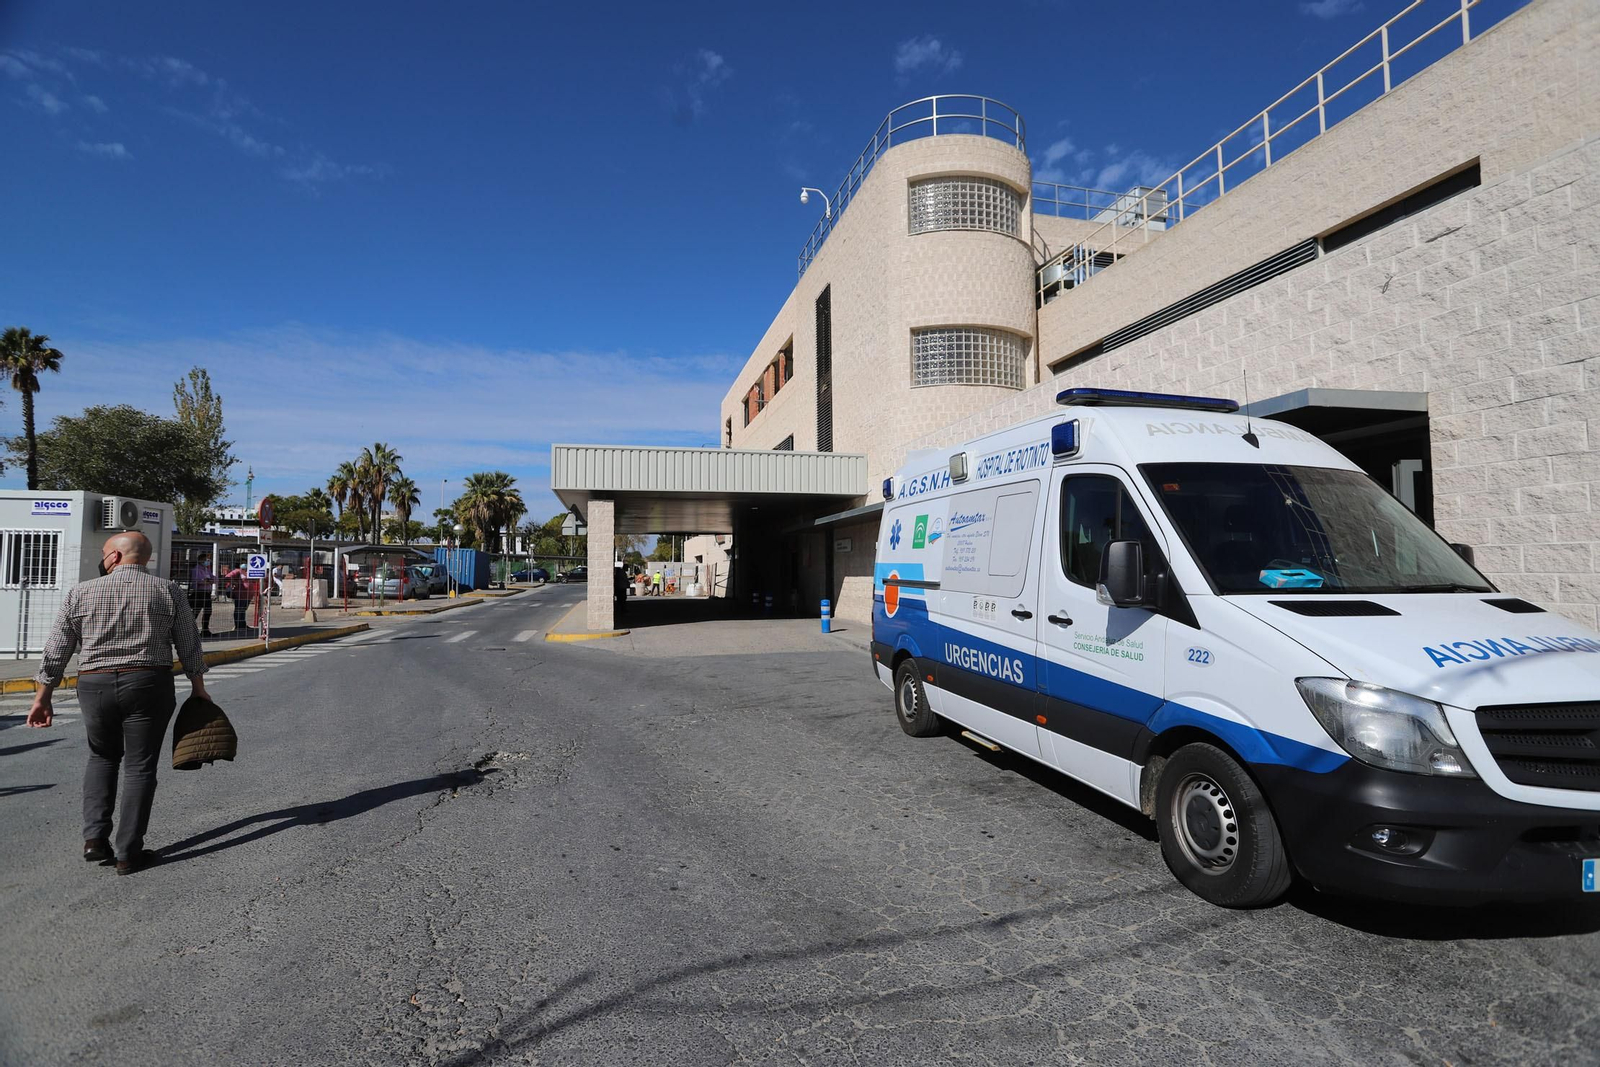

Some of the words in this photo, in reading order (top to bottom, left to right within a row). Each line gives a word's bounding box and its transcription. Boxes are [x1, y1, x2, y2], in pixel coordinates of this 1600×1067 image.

[977, 454, 1004, 480] HOSPITAL
[1004, 451, 1016, 474] DE
[1014, 442, 1049, 472] RIOTINTO
[34, 501, 68, 510] algeco
[1126, 638, 1144, 649] Salud
[1110, 648, 1120, 657] DE
[1120, 650, 1144, 661] SALUD
[1188, 648, 1210, 664] 222
[945, 642, 1024, 684] URGENCIAS
